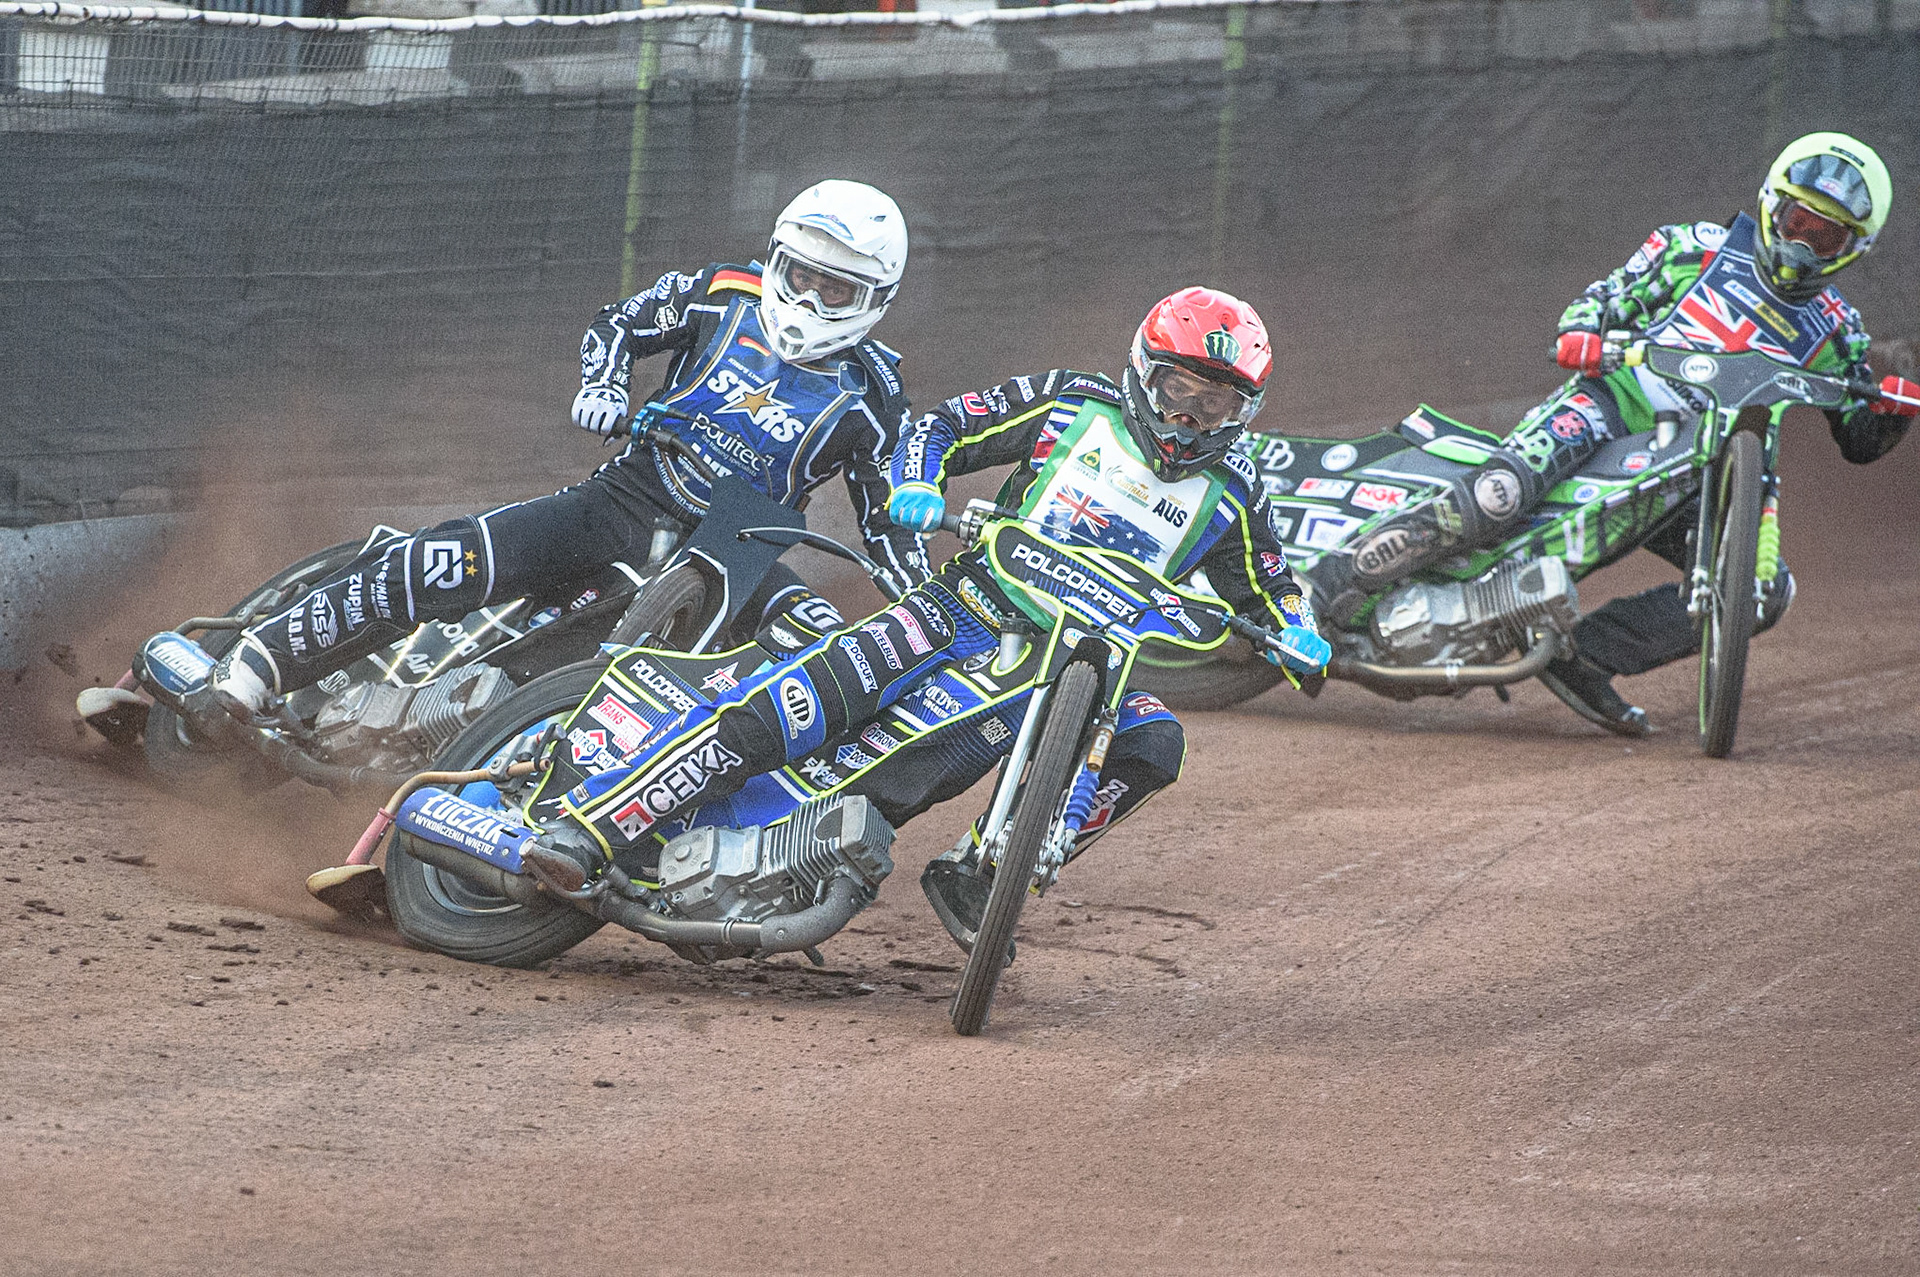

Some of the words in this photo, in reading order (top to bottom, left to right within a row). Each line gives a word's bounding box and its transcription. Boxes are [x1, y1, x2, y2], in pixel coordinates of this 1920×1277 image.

[1152, 496, 1188, 528] AUS
[1356, 486, 1403, 506] NGK
[849, 645, 877, 691] DOCUFY
